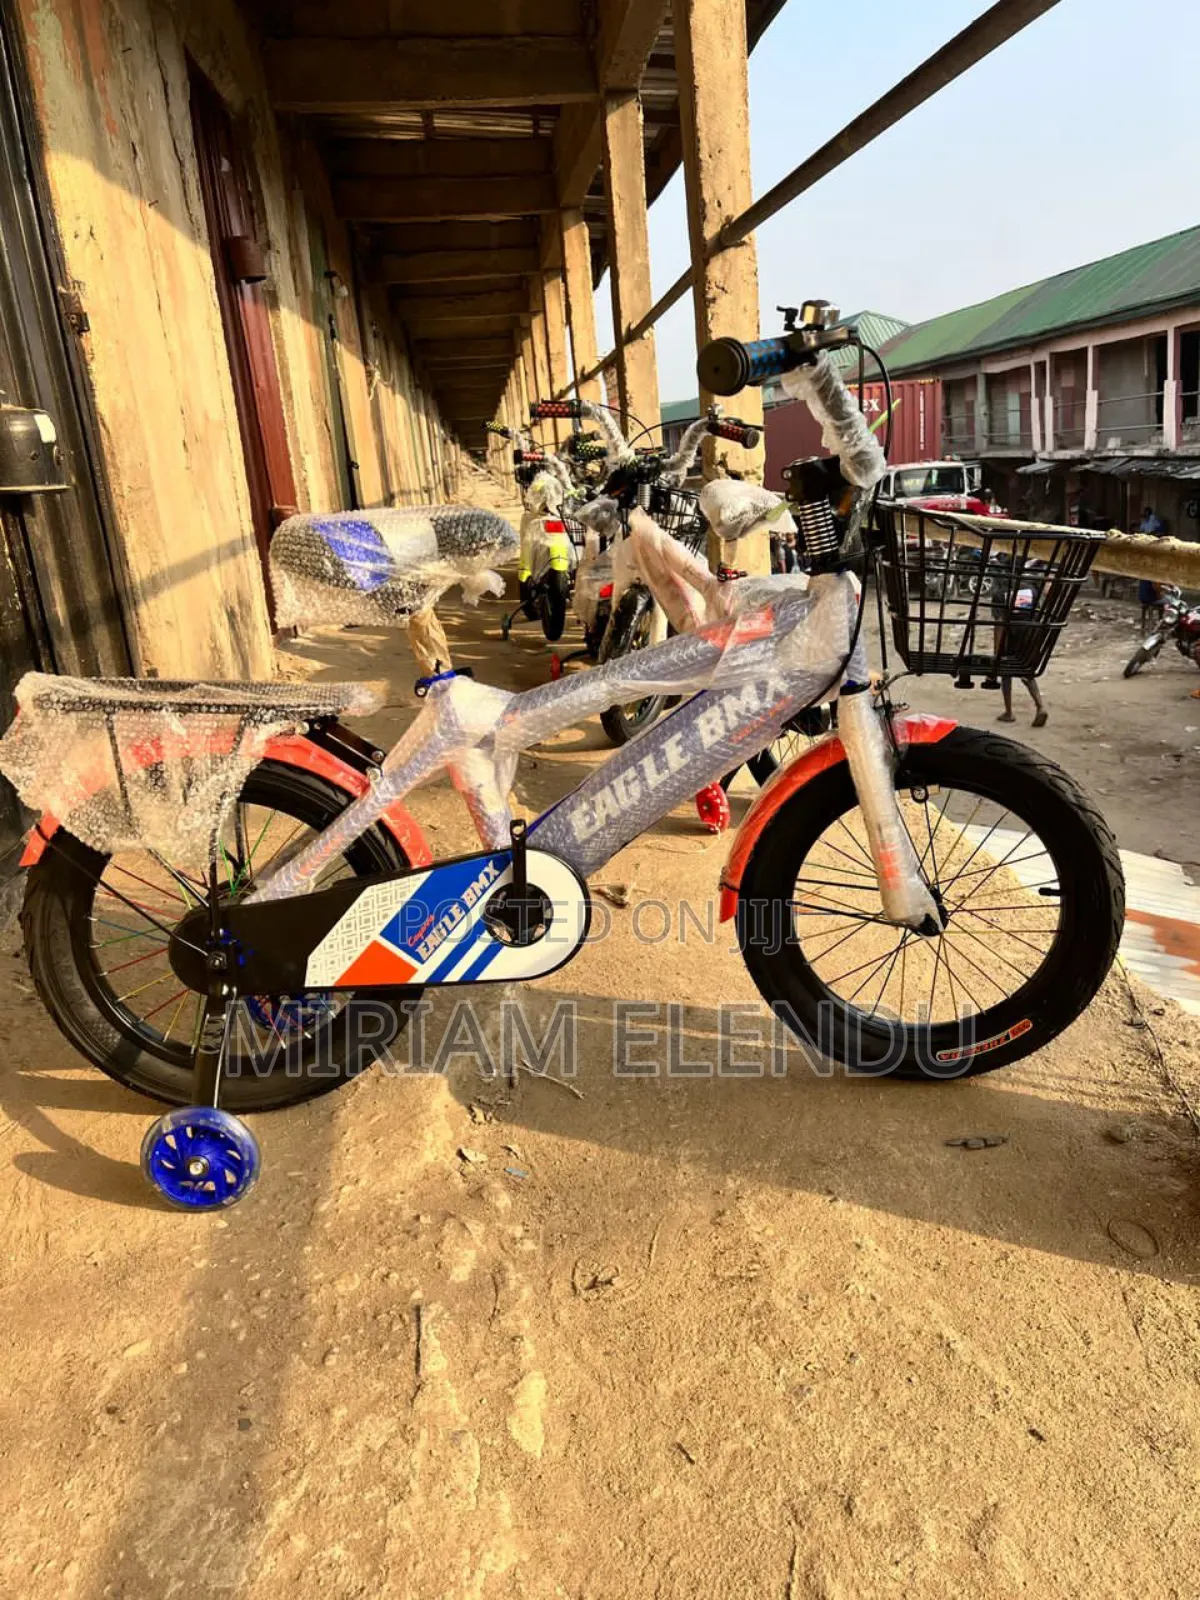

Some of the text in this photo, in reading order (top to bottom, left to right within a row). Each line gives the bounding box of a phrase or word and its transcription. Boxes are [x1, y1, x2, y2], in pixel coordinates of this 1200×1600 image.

[567, 732, 691, 843] EAGLE
[694, 677, 789, 750] BMX
[415, 859, 501, 961] EAGLE BMX
